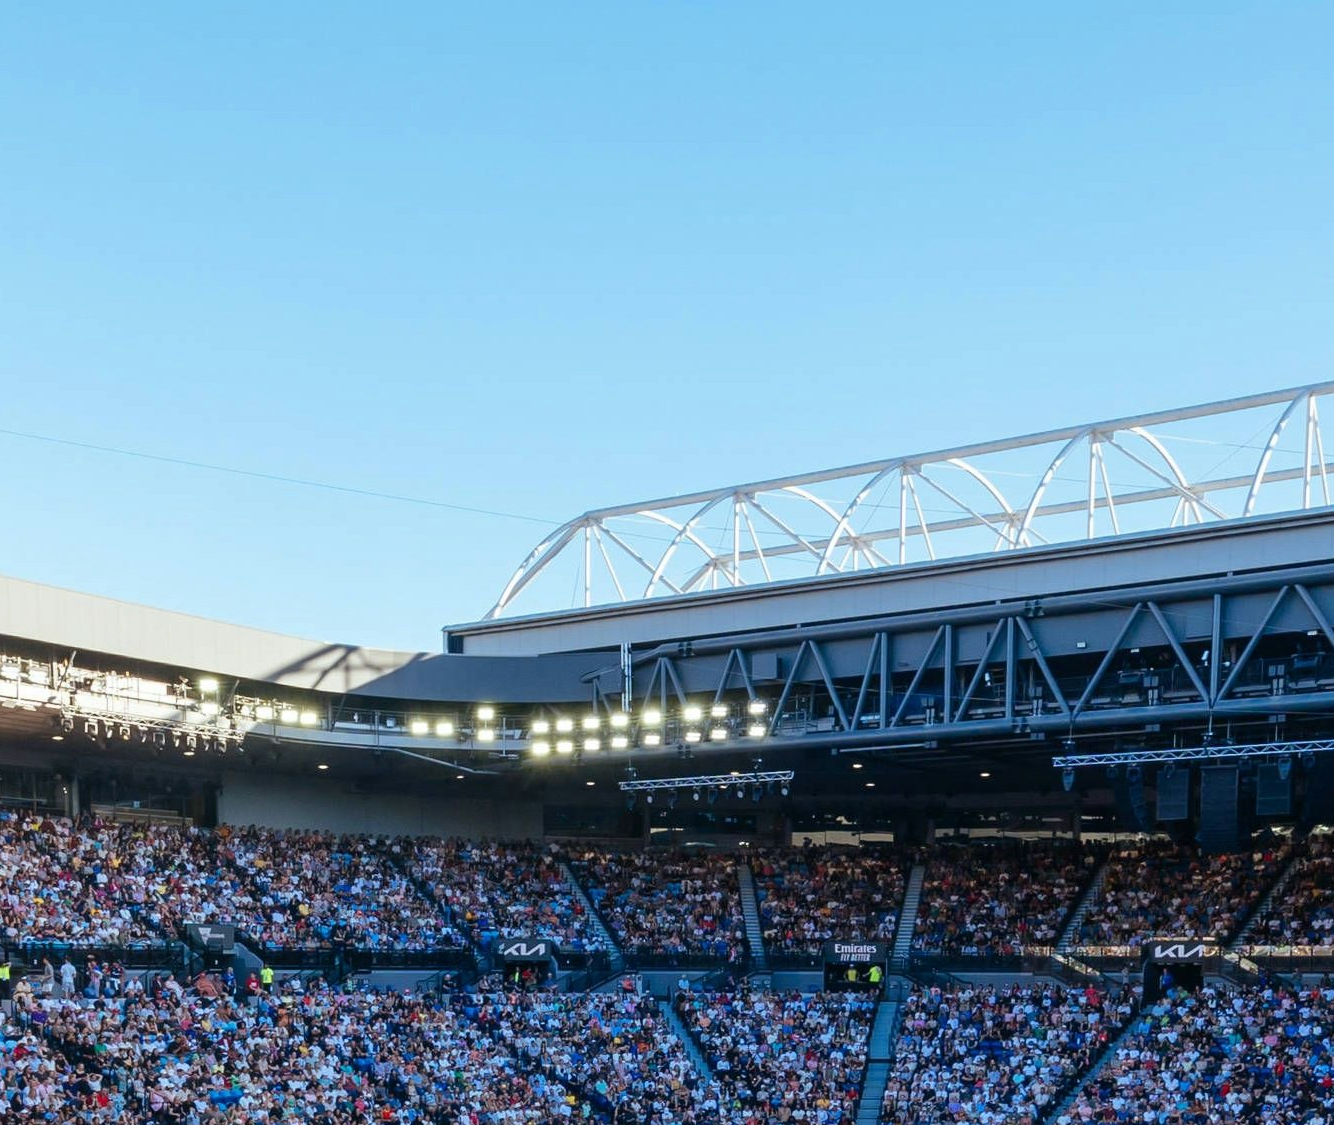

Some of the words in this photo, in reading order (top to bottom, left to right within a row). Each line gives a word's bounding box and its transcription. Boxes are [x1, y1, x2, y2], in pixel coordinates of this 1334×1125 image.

[503, 943, 546, 956] KIA
[834, 943, 877, 954] Emirates
[1154, 943, 1206, 959] KIA
